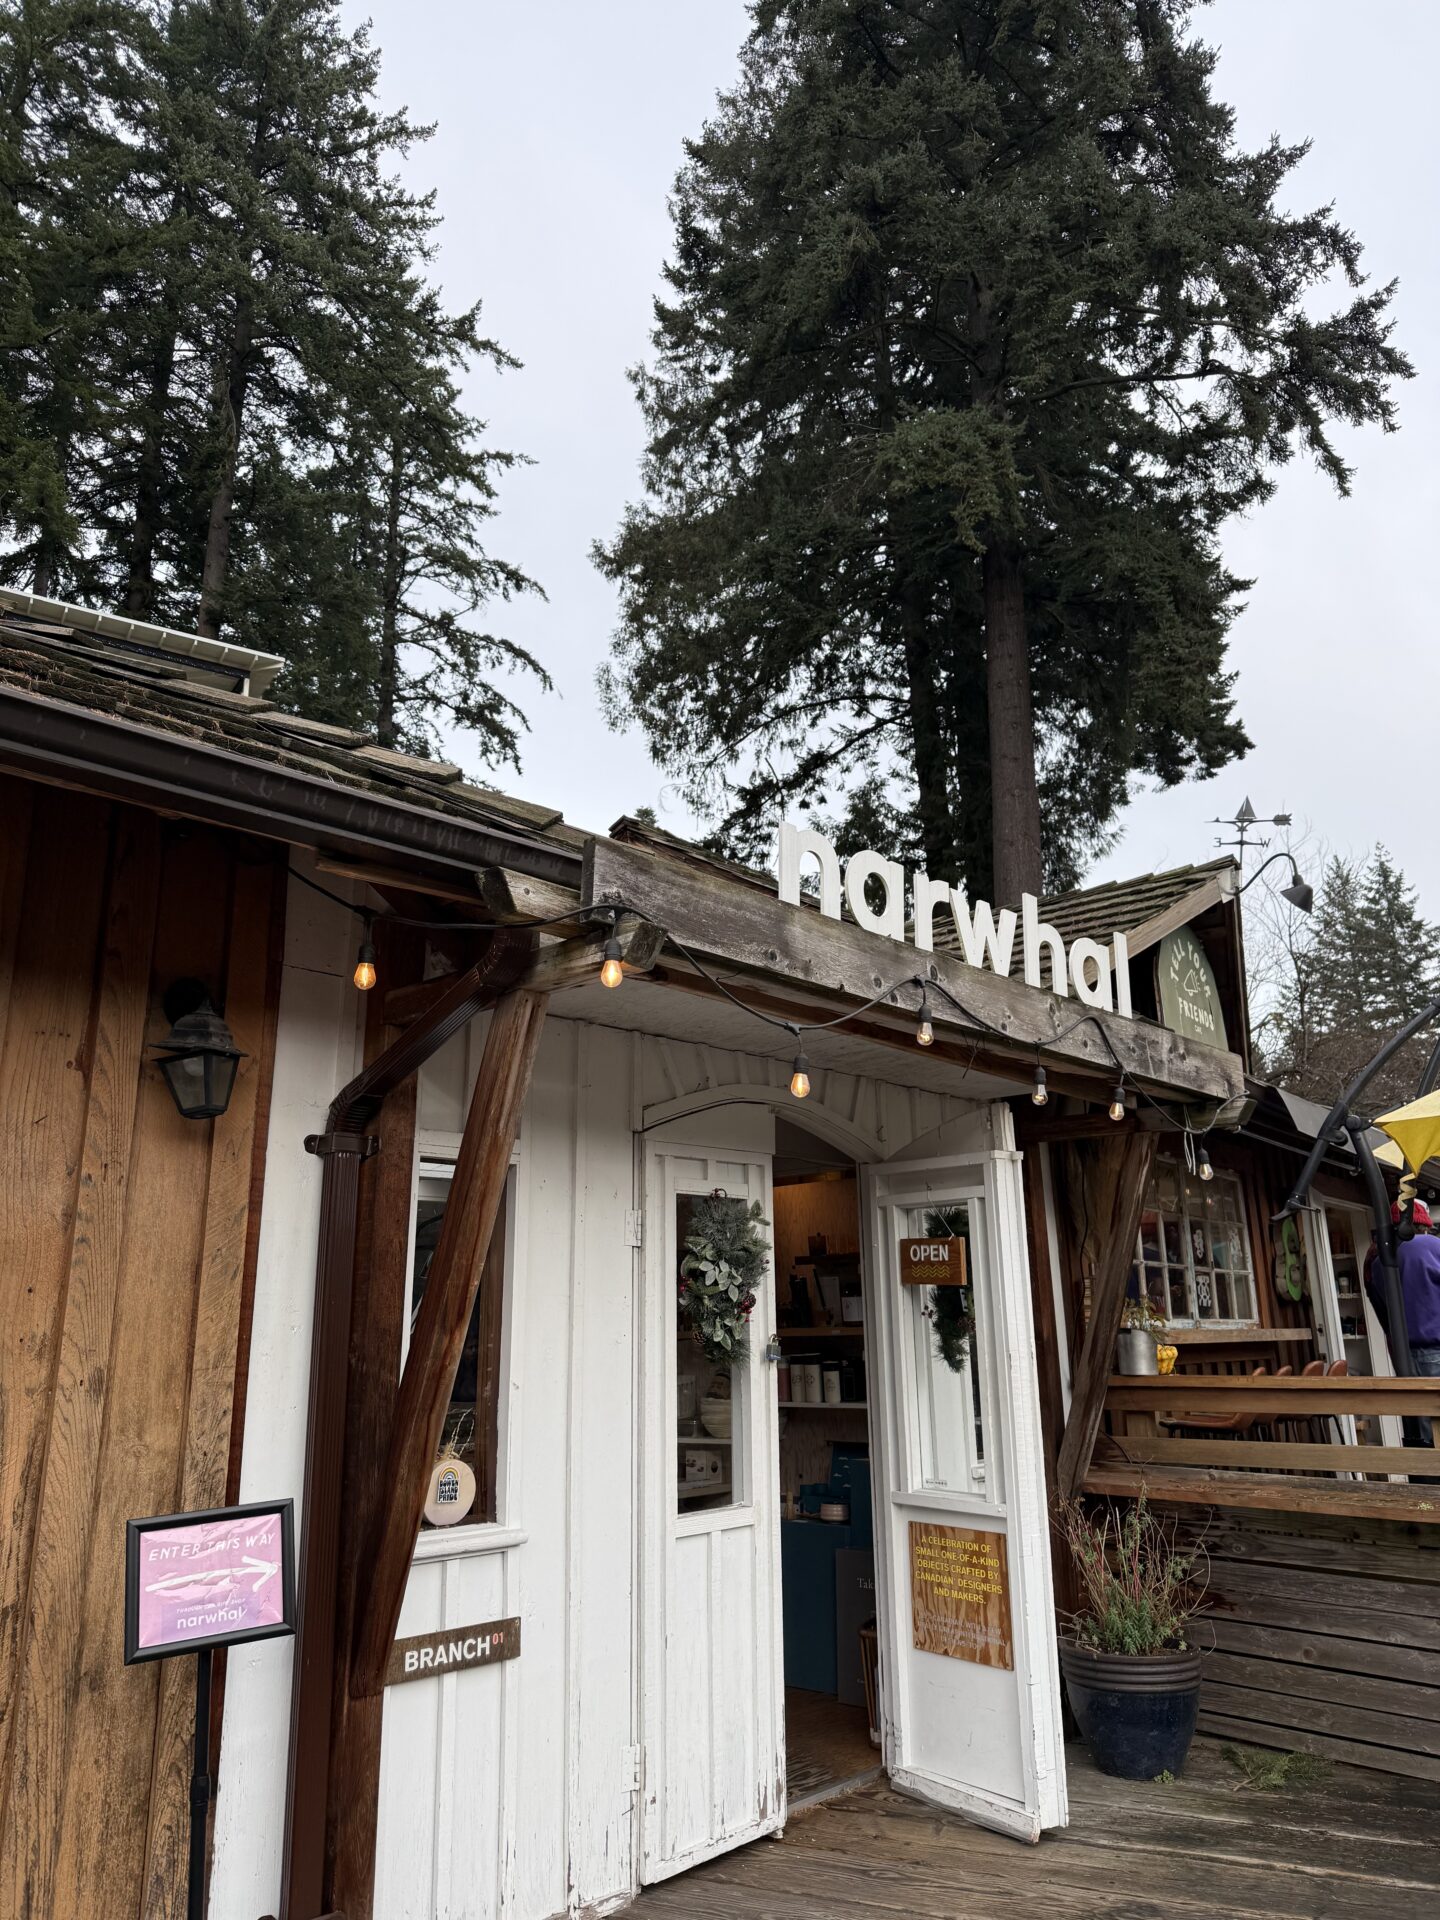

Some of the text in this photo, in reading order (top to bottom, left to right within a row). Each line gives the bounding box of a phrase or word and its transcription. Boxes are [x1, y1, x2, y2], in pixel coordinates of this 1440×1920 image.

[778, 821, 1133, 1019] narwhal
[1170, 938, 1211, 998] TELL YOUR
[1178, 997, 1215, 1031] FRIENDS
[909, 1244, 949, 1261] OPEN
[439, 1493, 458, 1501] PRIDE
[148, 1532, 276, 1561] ENTER THIS WAY
[921, 1535, 992, 1553] A CELEBRATION OF
[915, 1546, 1000, 1568] SMALL ONE-OF-A-KIND
[917, 1558, 999, 1580] OBJECTS CRAFTED BY
[915, 1571, 1003, 1594] CANADIAN DESIGNERS
[933, 1586, 987, 1604] AND MAKERS.
[177, 1606, 243, 1629] narwhal
[404, 1631, 504, 1672] BRANCH 01
